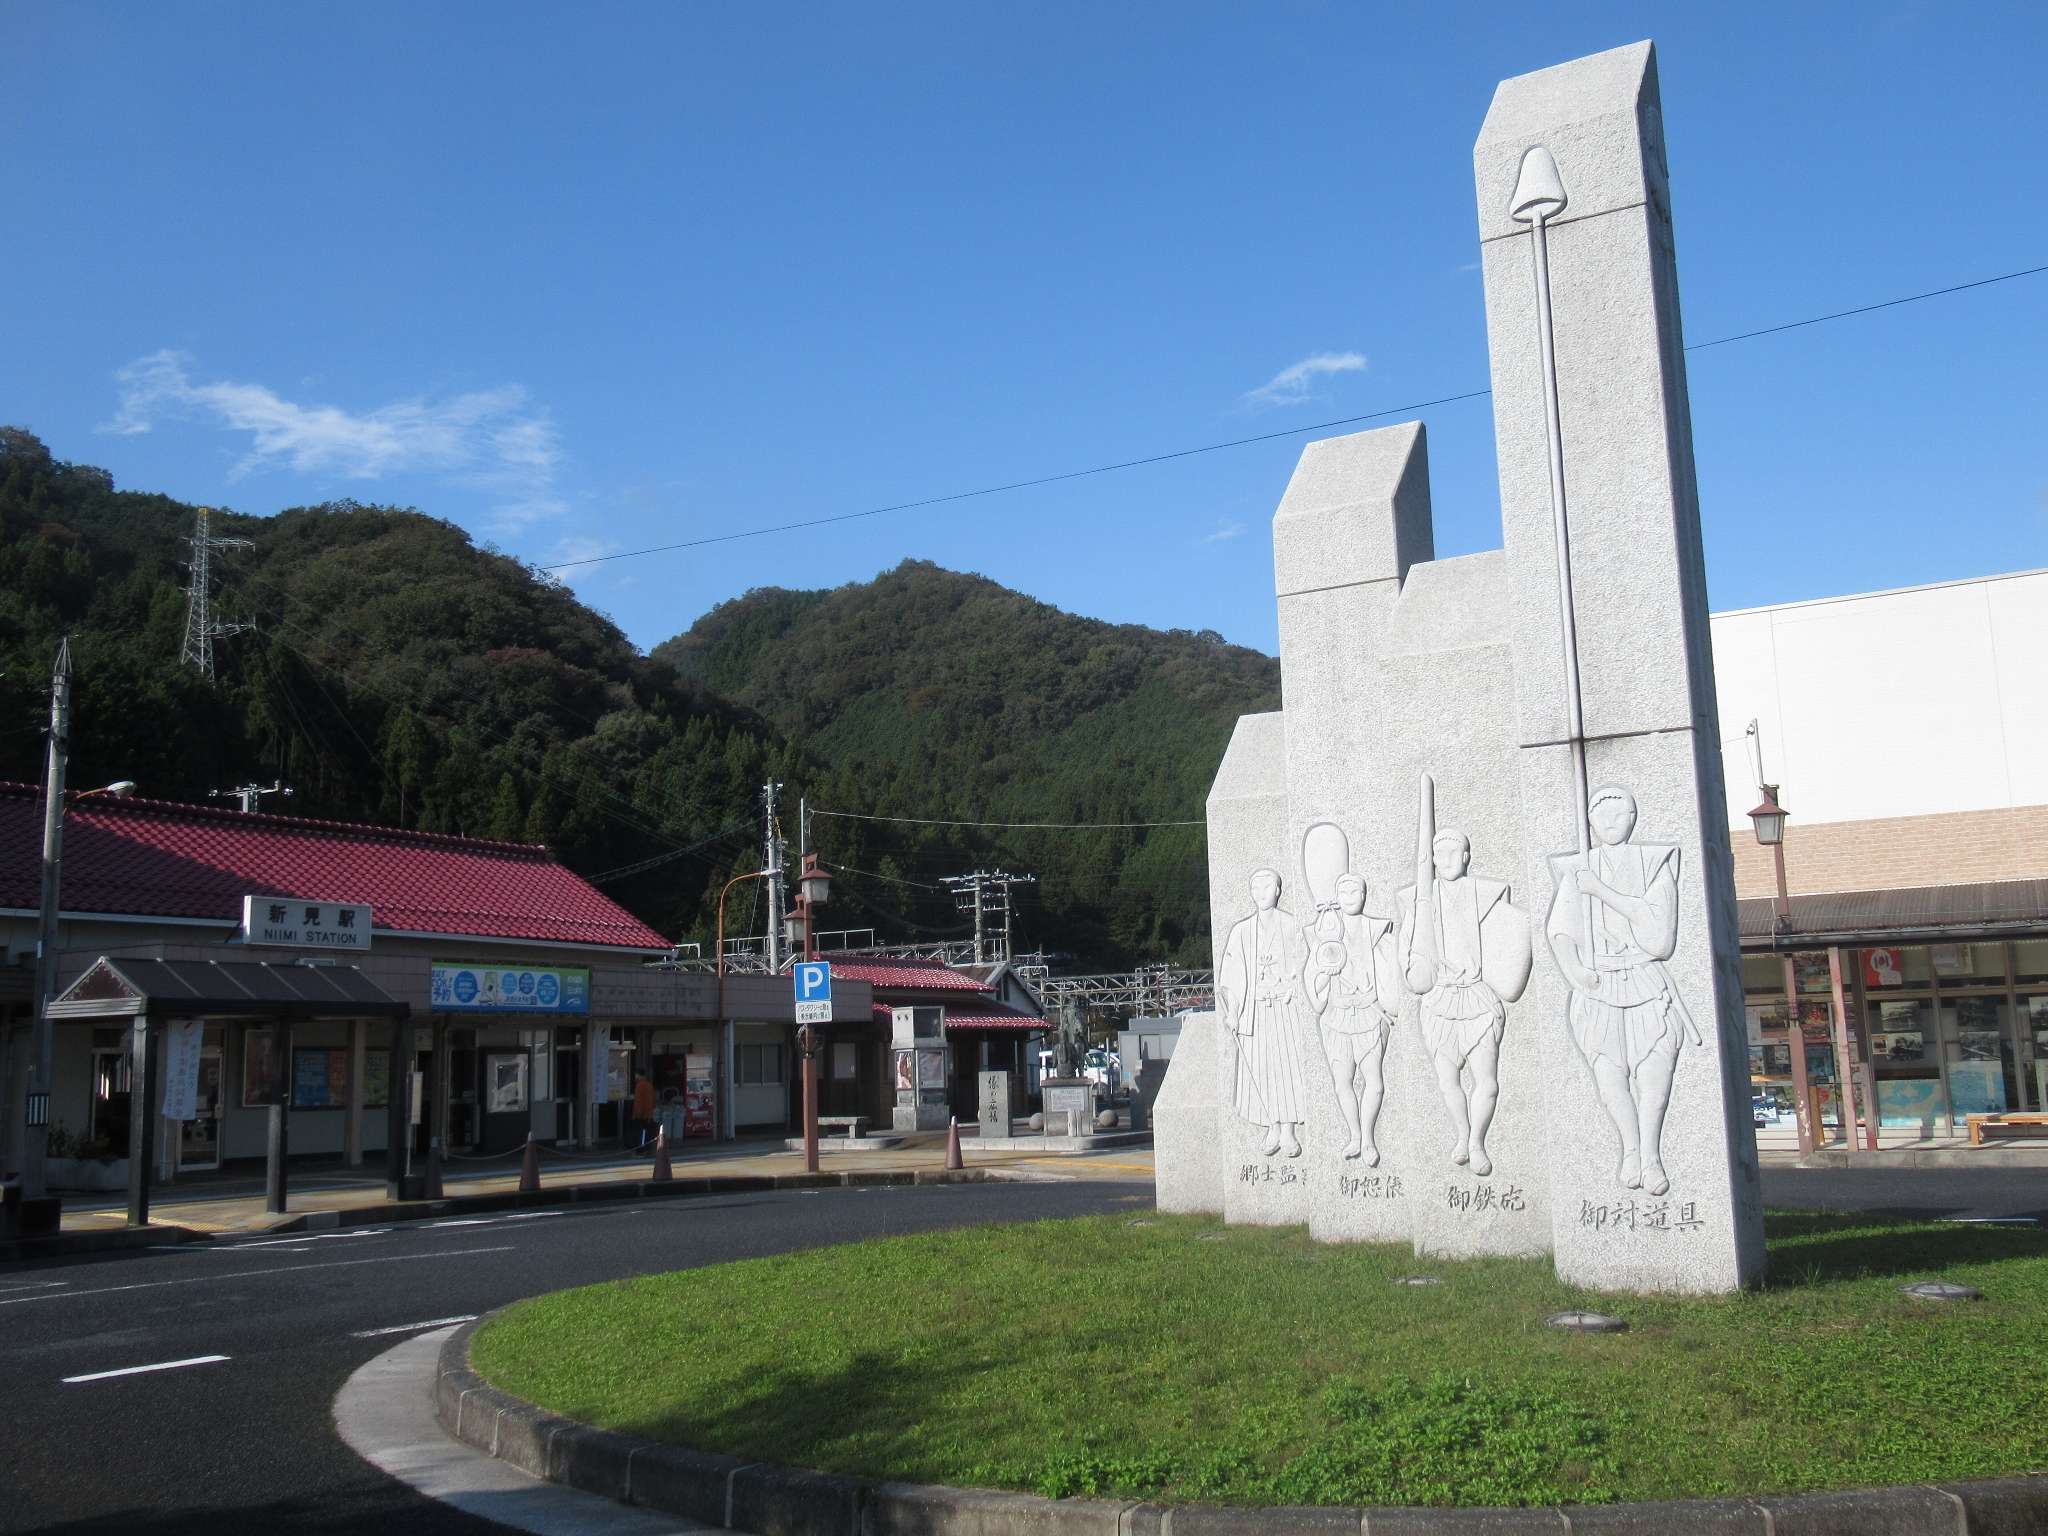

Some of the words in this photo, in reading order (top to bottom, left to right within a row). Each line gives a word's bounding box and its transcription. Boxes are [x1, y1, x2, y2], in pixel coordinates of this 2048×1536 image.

[268, 903, 356, 929] 新見駅
[264, 928, 298, 942] NIIMI
[306, 930, 357, 945] STATION
[803, 966, 824, 998] P
[1447, 1184, 1526, 1212] 御鉄砲
[1579, 1199, 1705, 1232] 御対道具
